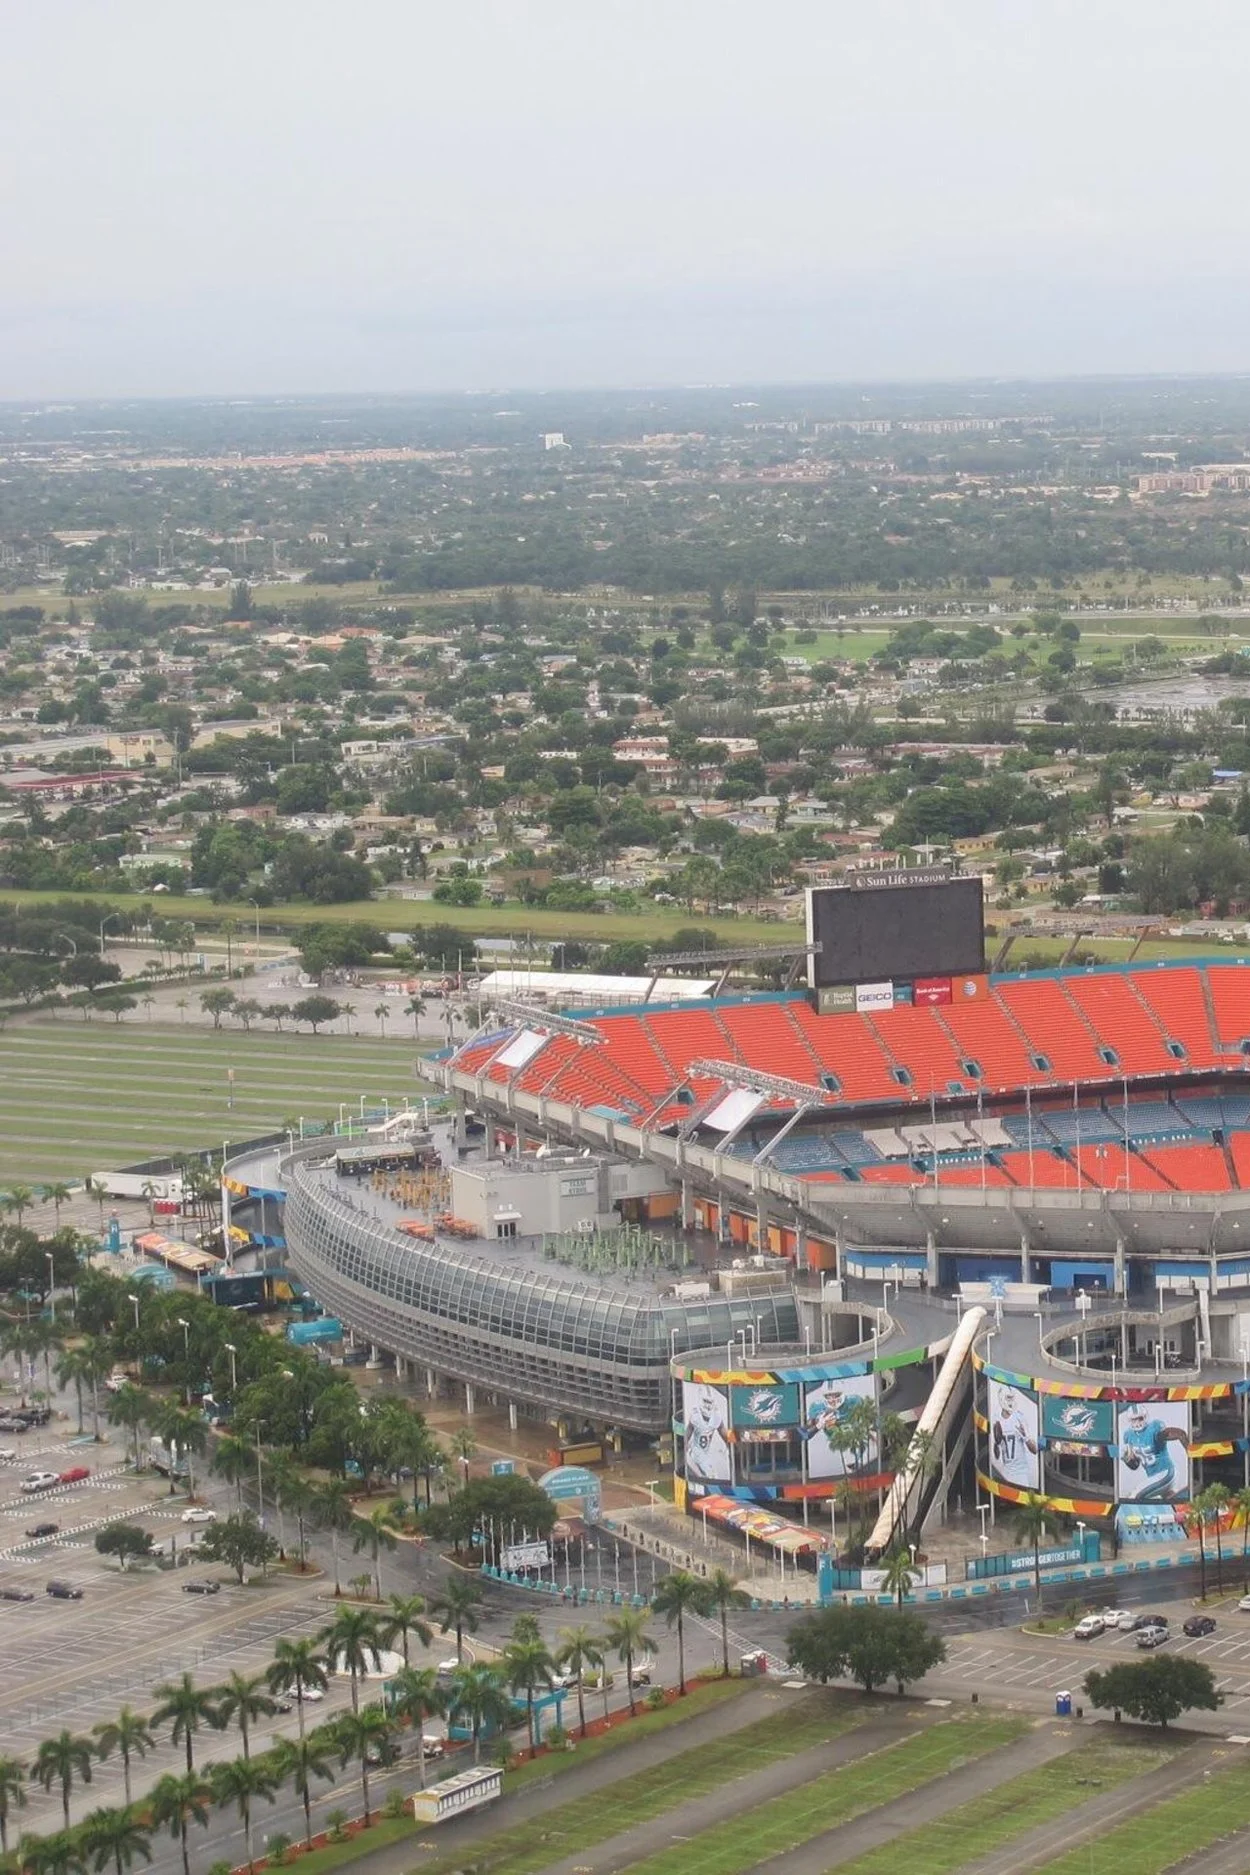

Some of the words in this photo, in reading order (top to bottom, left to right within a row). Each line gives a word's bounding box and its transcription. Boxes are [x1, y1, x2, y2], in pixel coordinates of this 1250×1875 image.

[866, 876, 886, 887] Sun
[888, 874, 908, 885] Life
[909, 874, 946, 884] STADIUM
[858, 992, 892, 1002] GEICO
